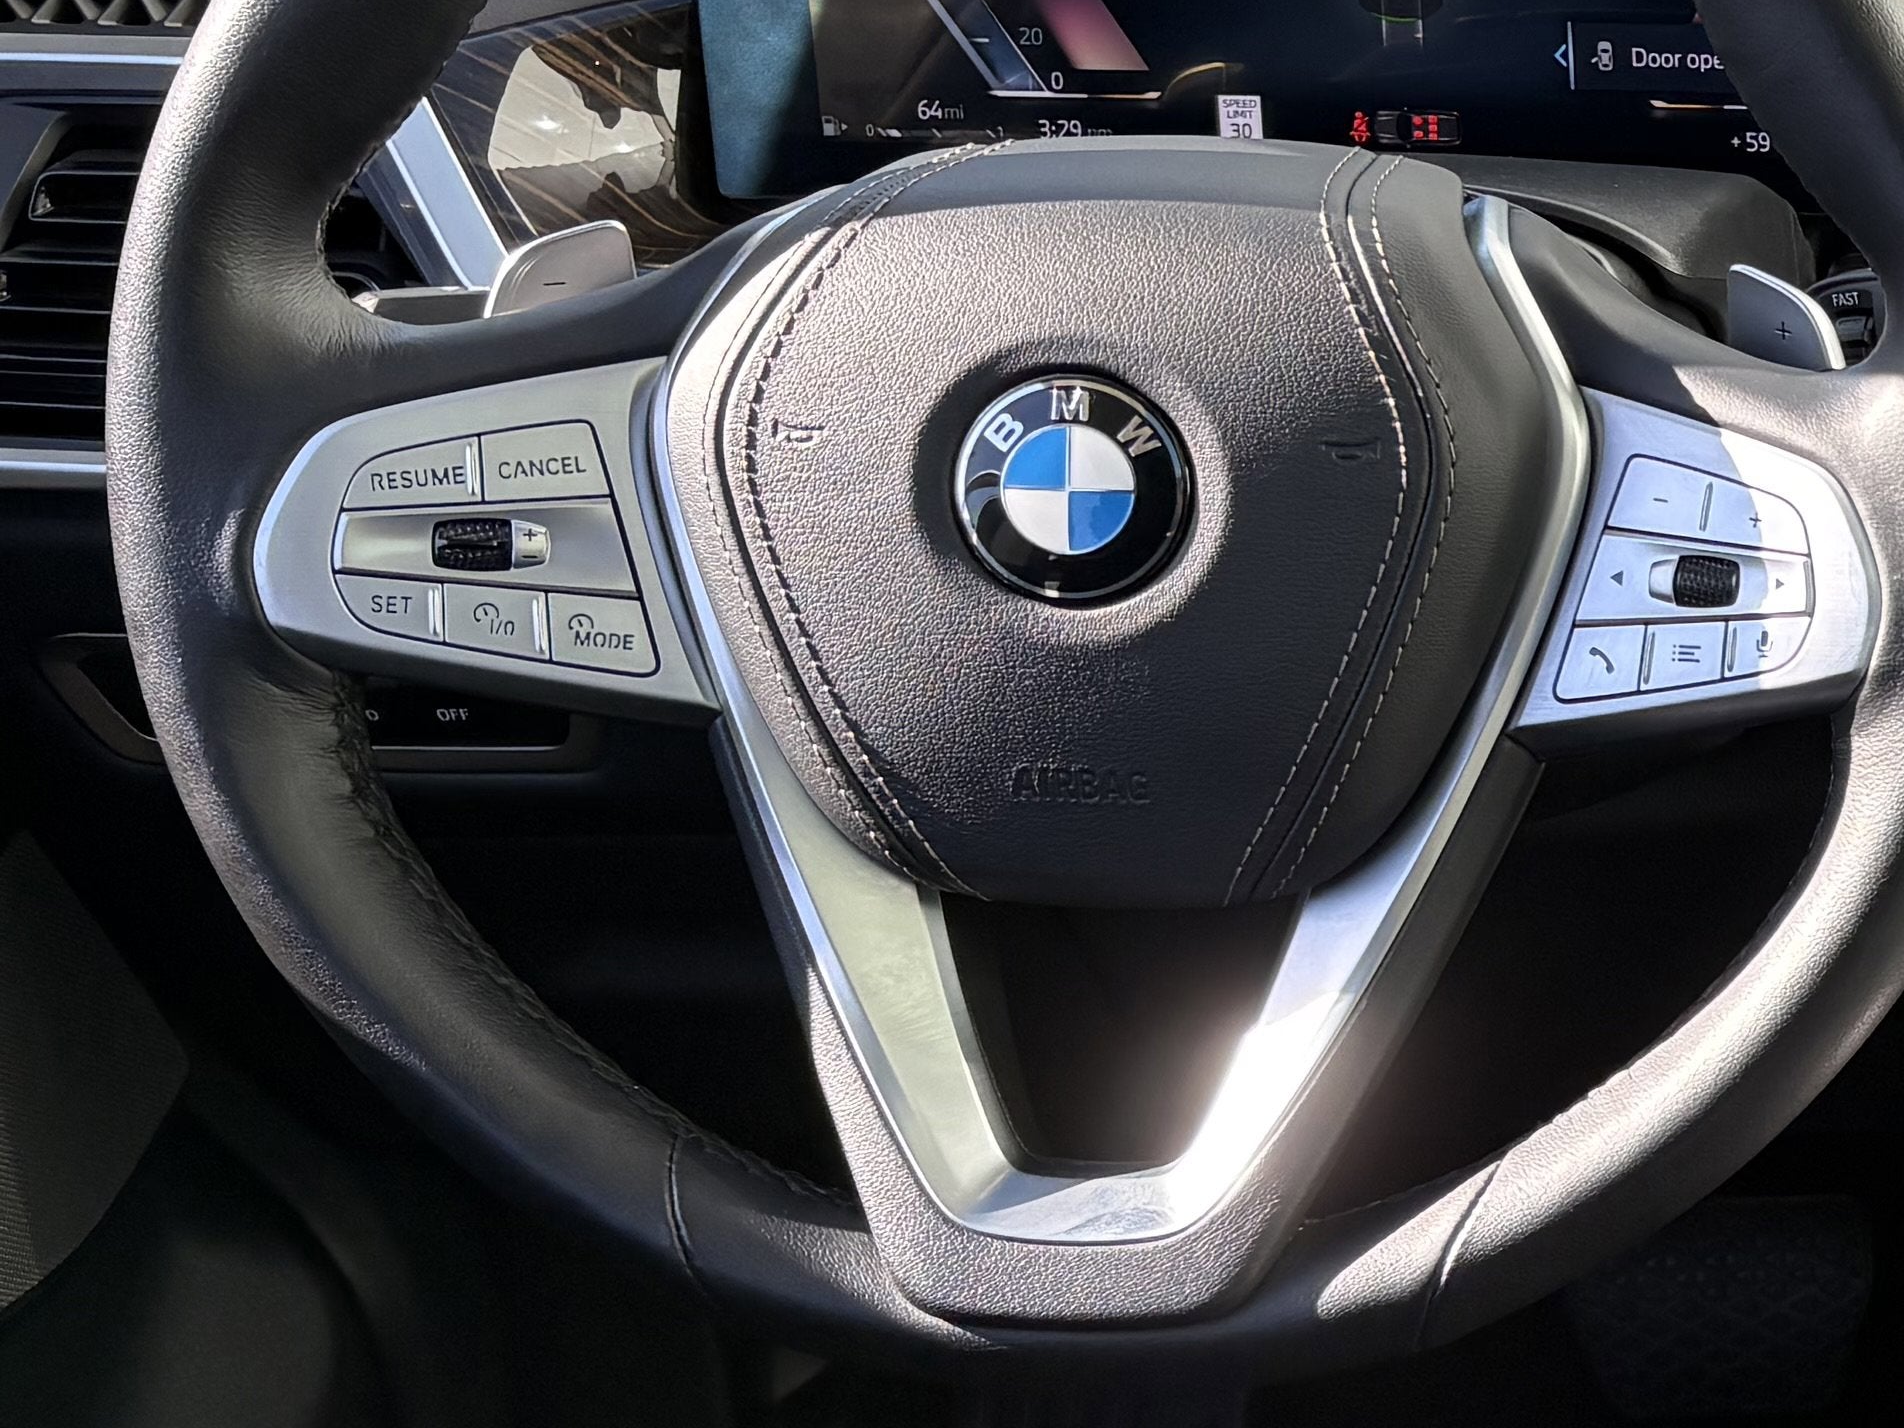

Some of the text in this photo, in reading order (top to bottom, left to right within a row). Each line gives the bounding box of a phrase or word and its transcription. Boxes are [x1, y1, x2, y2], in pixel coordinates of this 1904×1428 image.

[1019, 28, 1043, 46] 20
[1631, 47, 1725, 72] Door ope
[1051, 72, 1064, 90] 0
[1222, 98, 1257, 109] SPEED
[1227, 110, 1254, 120] LIMIT
[1038, 120, 1082, 138] 3:29
[1230, 123, 1253, 140] 30
[1832, 291, 1860, 307] FAST
[983, 385, 1162, 458] BMW
[498, 456, 587, 480] CANCEL
[371, 465, 466, 492] RESUME
[371, 595, 413, 615] SET
[573, 630, 636, 651] MODE
[436, 708, 469, 722] OFF
